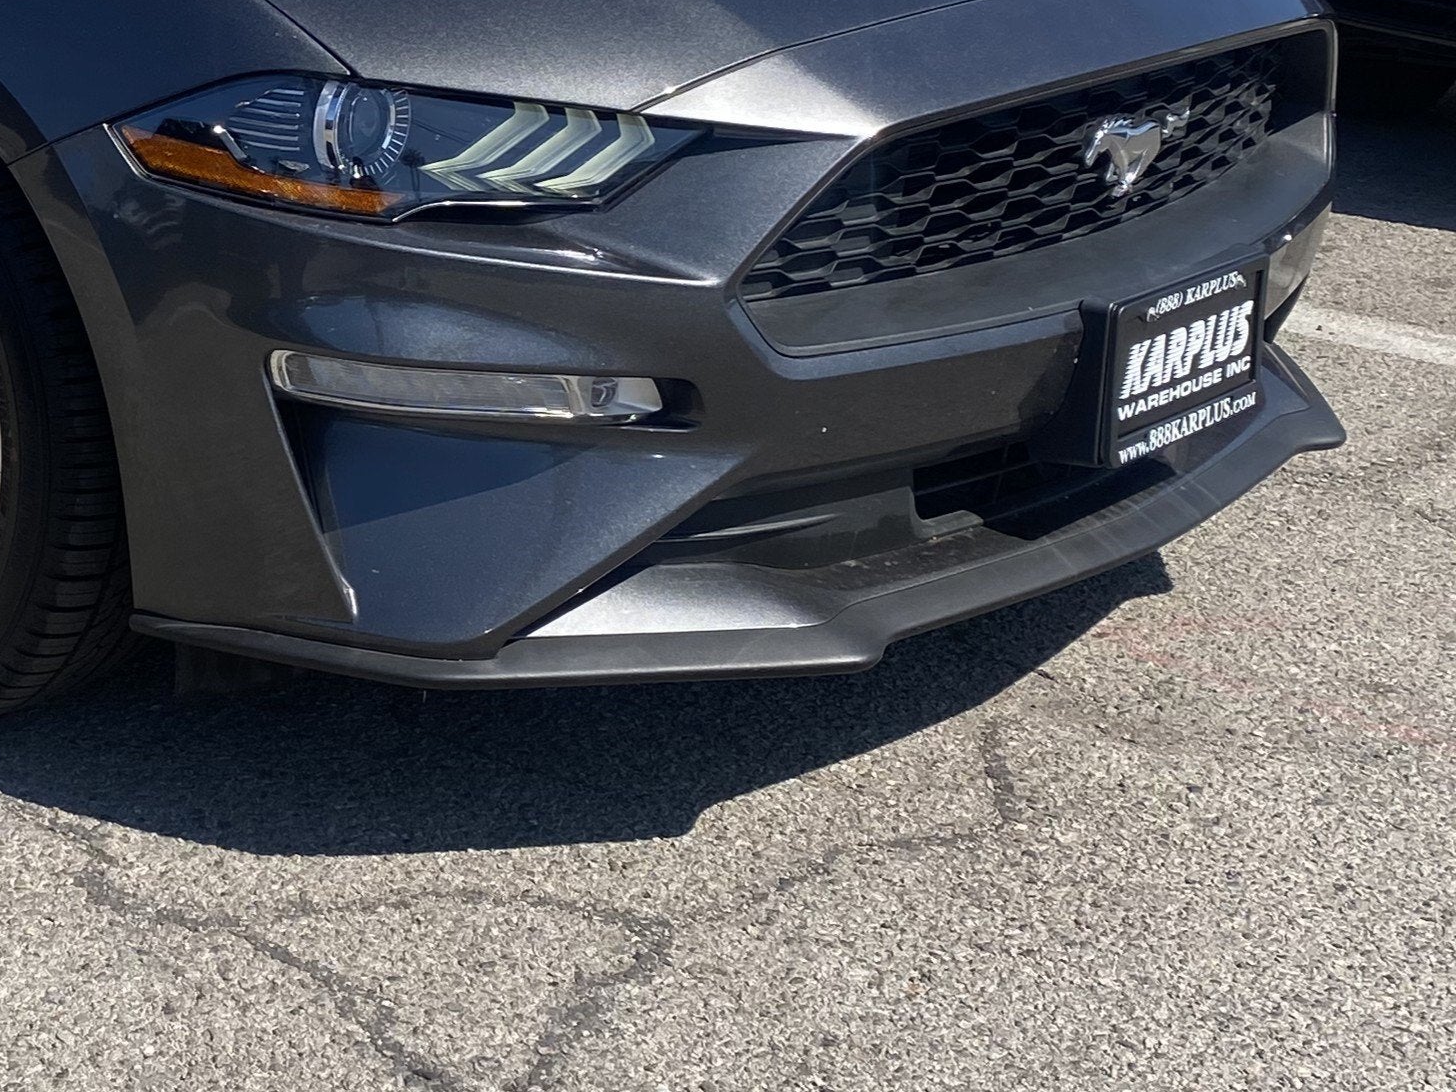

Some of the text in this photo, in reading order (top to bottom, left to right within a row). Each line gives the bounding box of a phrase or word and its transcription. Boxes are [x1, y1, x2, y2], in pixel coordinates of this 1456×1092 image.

[1156, 271, 1237, 316] (888) KARPLUS
[1118, 300, 1254, 399] KARPLUS
[1118, 356, 1251, 421] WAREHOUSE INC
